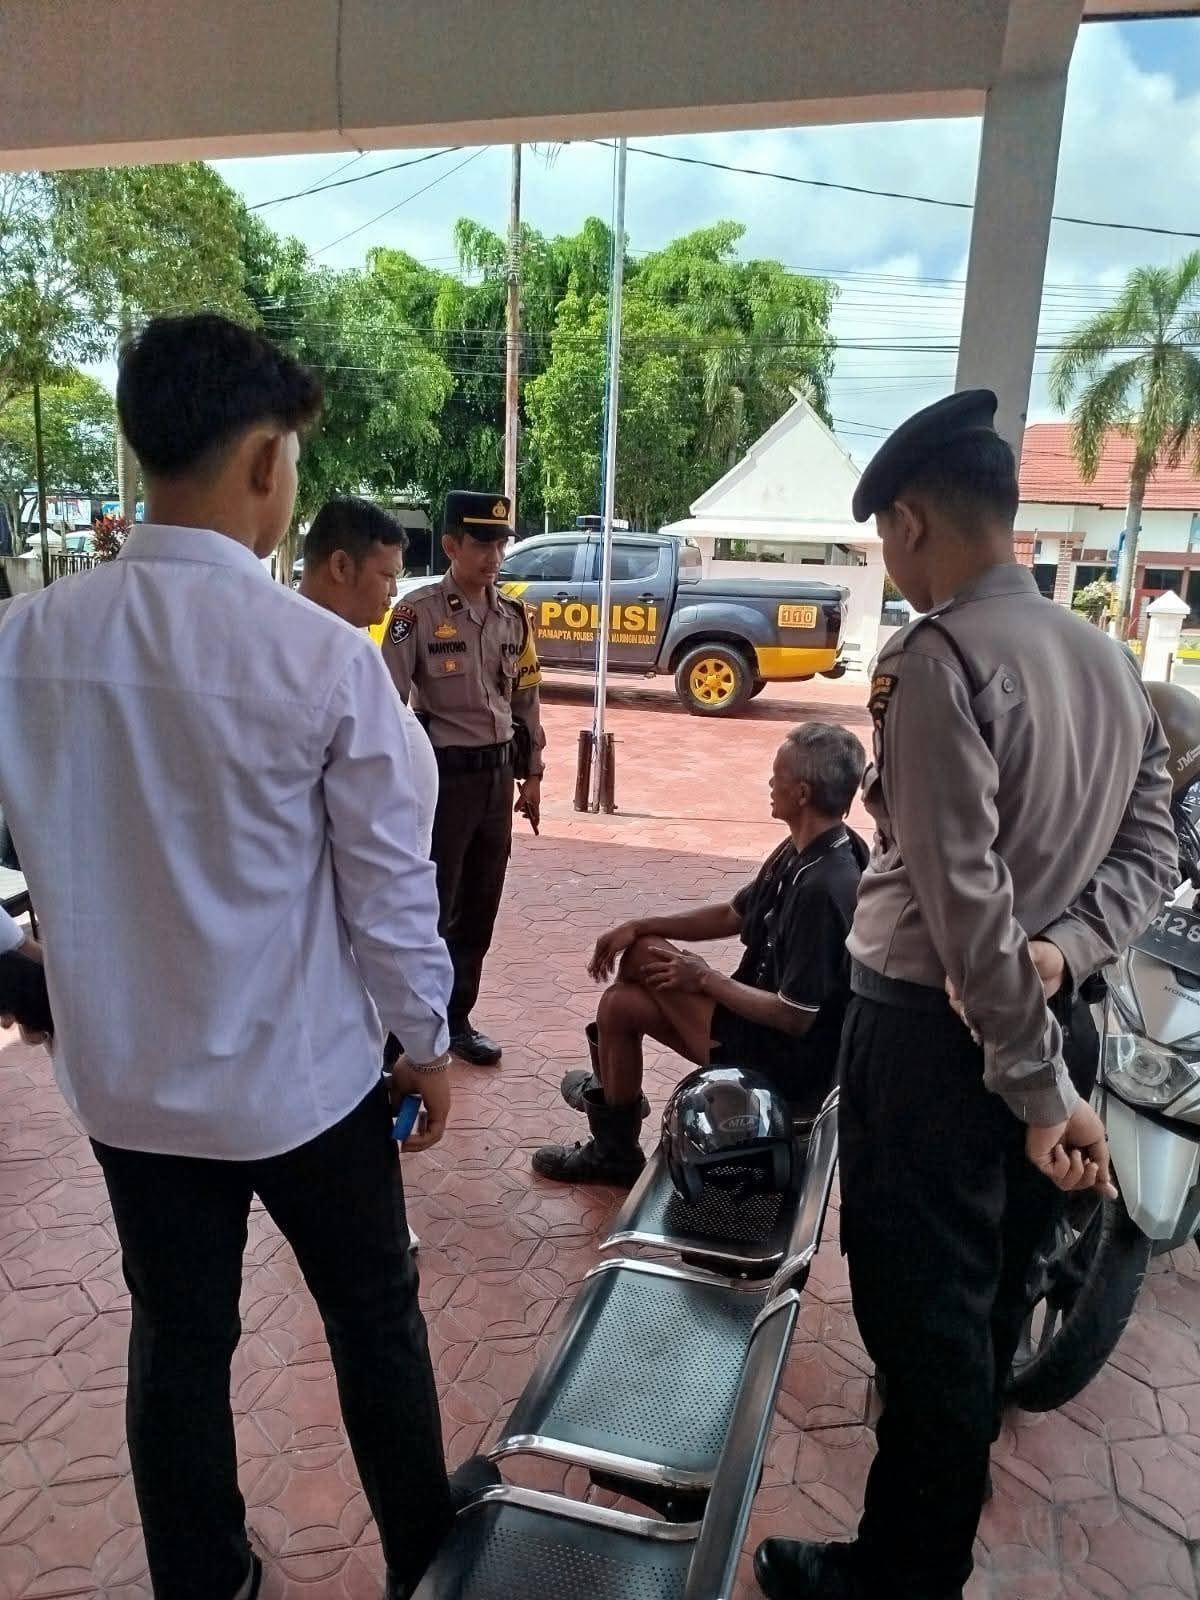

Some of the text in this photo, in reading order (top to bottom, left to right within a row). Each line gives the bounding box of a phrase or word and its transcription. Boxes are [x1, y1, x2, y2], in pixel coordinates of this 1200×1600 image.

[541, 602, 657, 632] POLISI
[782, 610, 812, 623] 110
[538, 628, 571, 640] PAMAPTA
